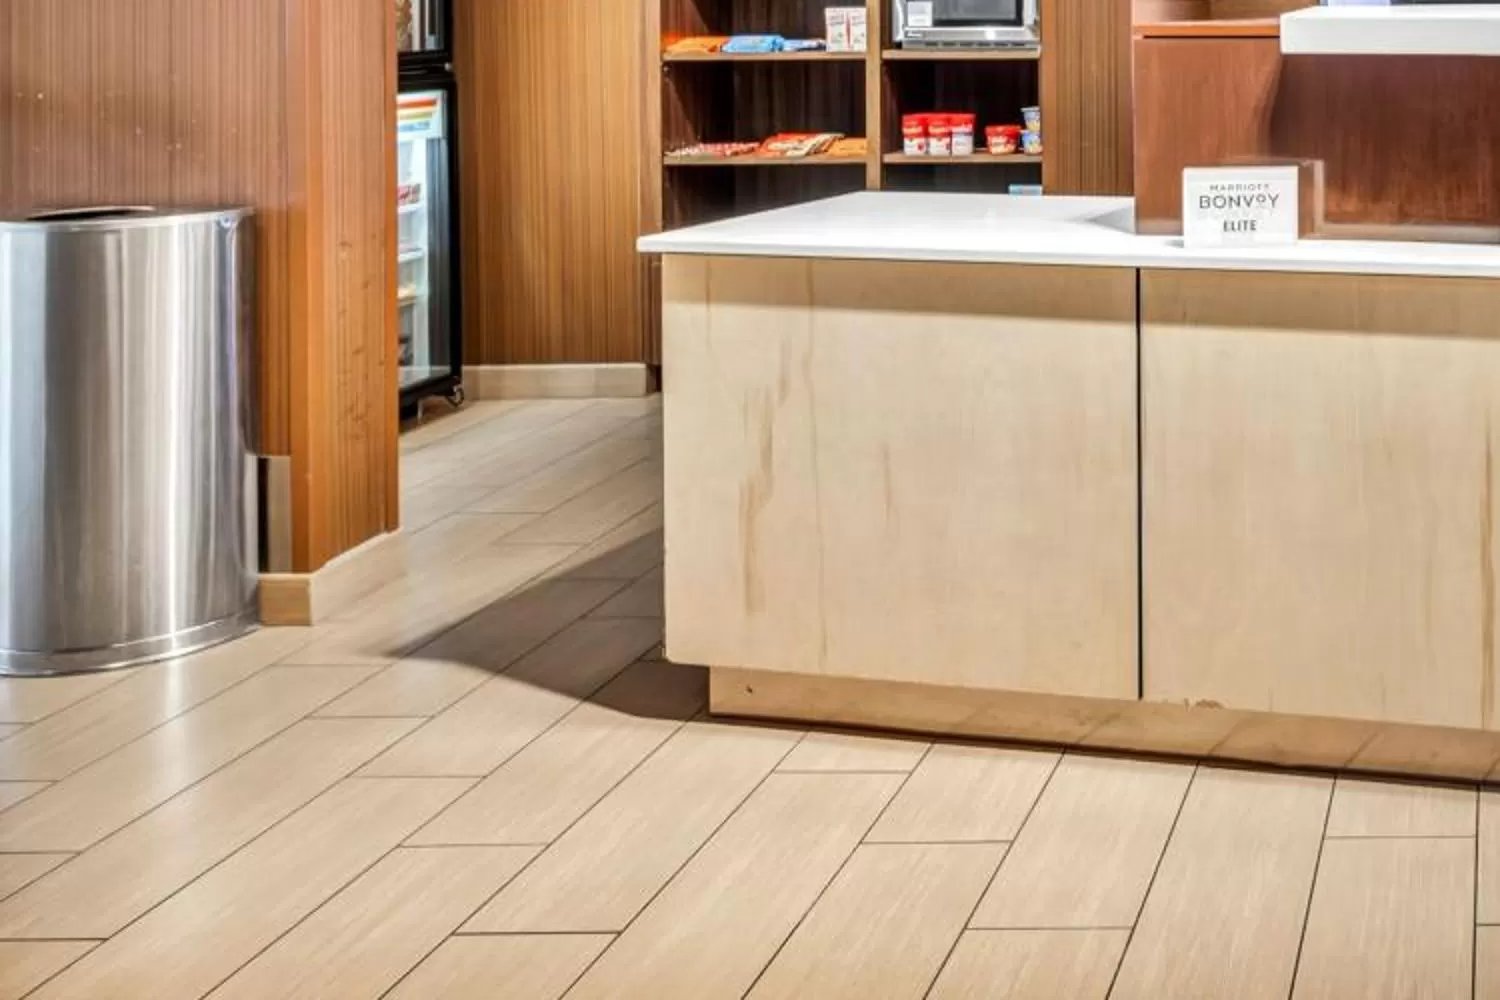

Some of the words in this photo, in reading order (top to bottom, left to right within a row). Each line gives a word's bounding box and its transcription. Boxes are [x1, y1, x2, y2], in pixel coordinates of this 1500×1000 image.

[1209, 183, 1270, 191] MARRIOTT
[1199, 192, 1280, 209] BONVOY
[1223, 219, 1258, 232] ELITE
